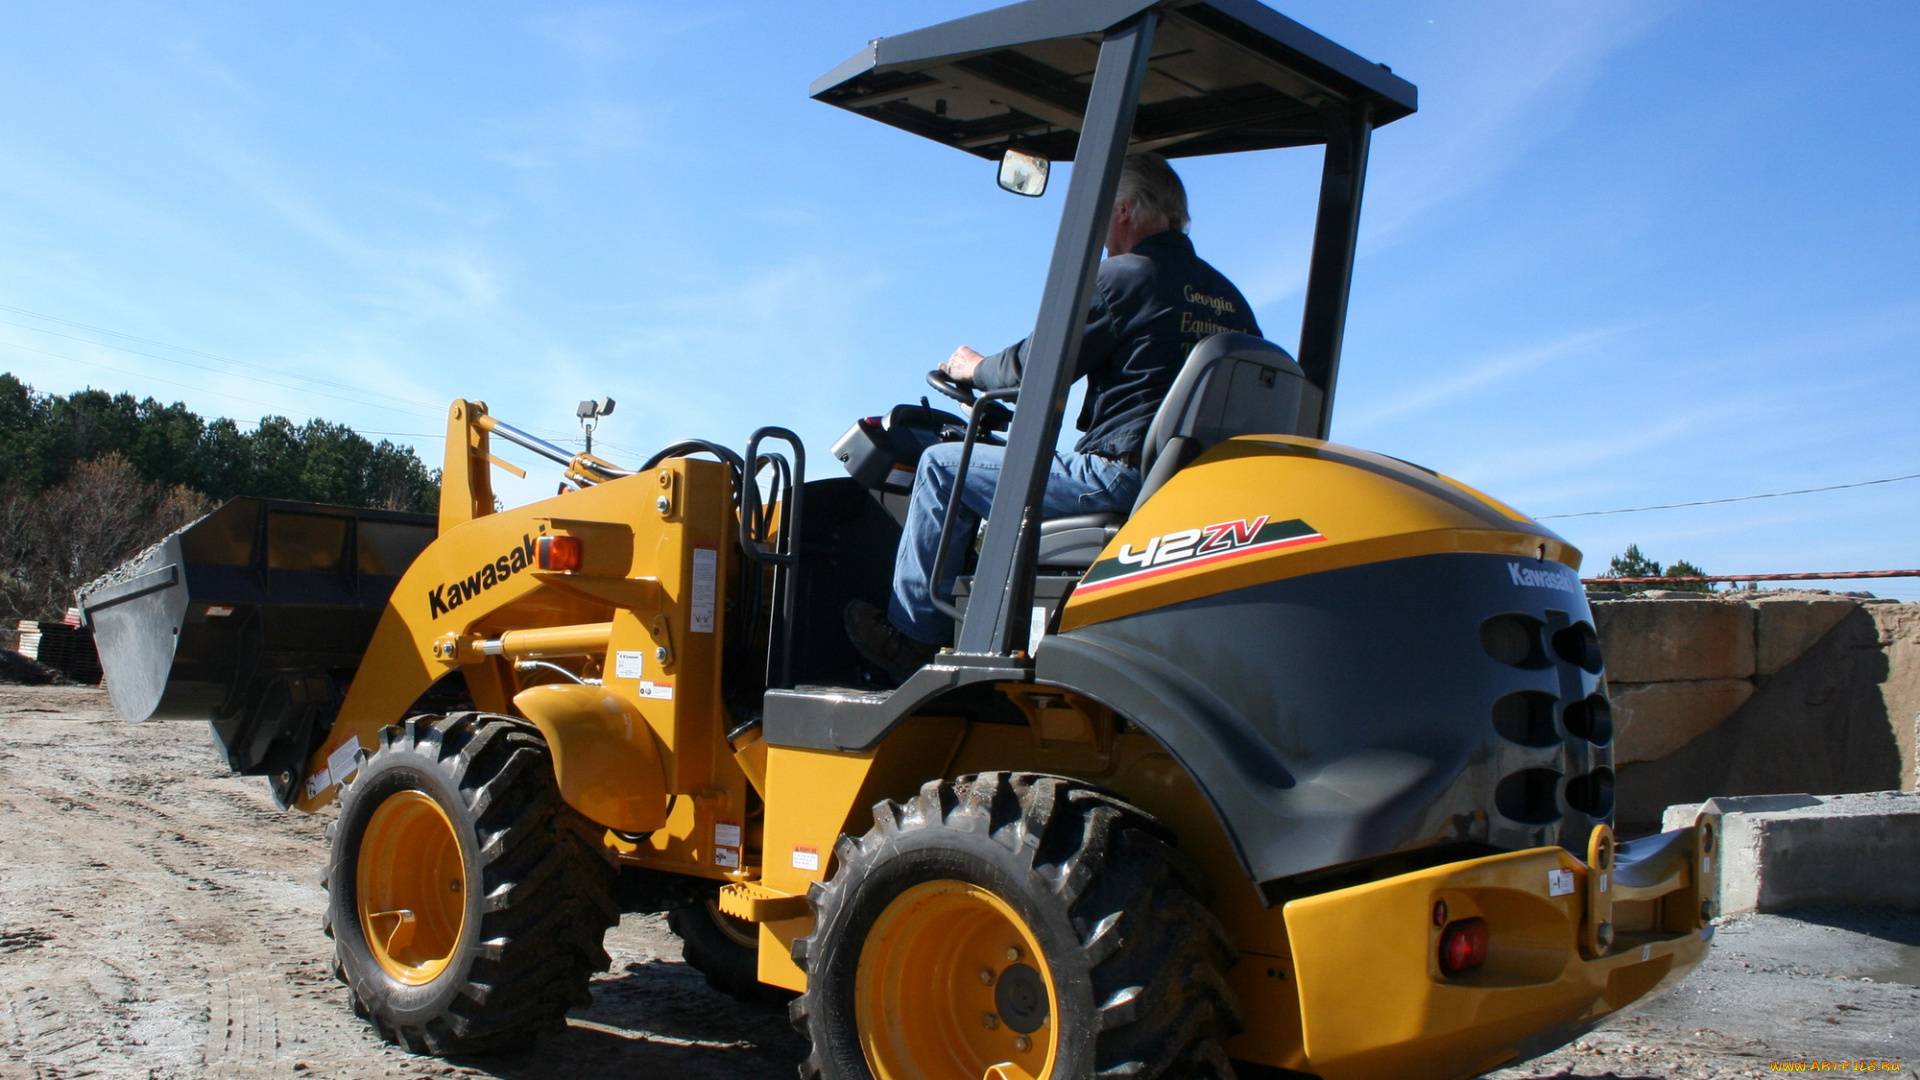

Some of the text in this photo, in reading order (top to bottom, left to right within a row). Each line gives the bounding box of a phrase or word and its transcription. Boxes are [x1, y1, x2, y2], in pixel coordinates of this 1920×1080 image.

[1183, 284, 1236, 316] Georgia
[1117, 514, 1271, 568] 42ZV
[1507, 562, 1575, 594] Kawasaki
